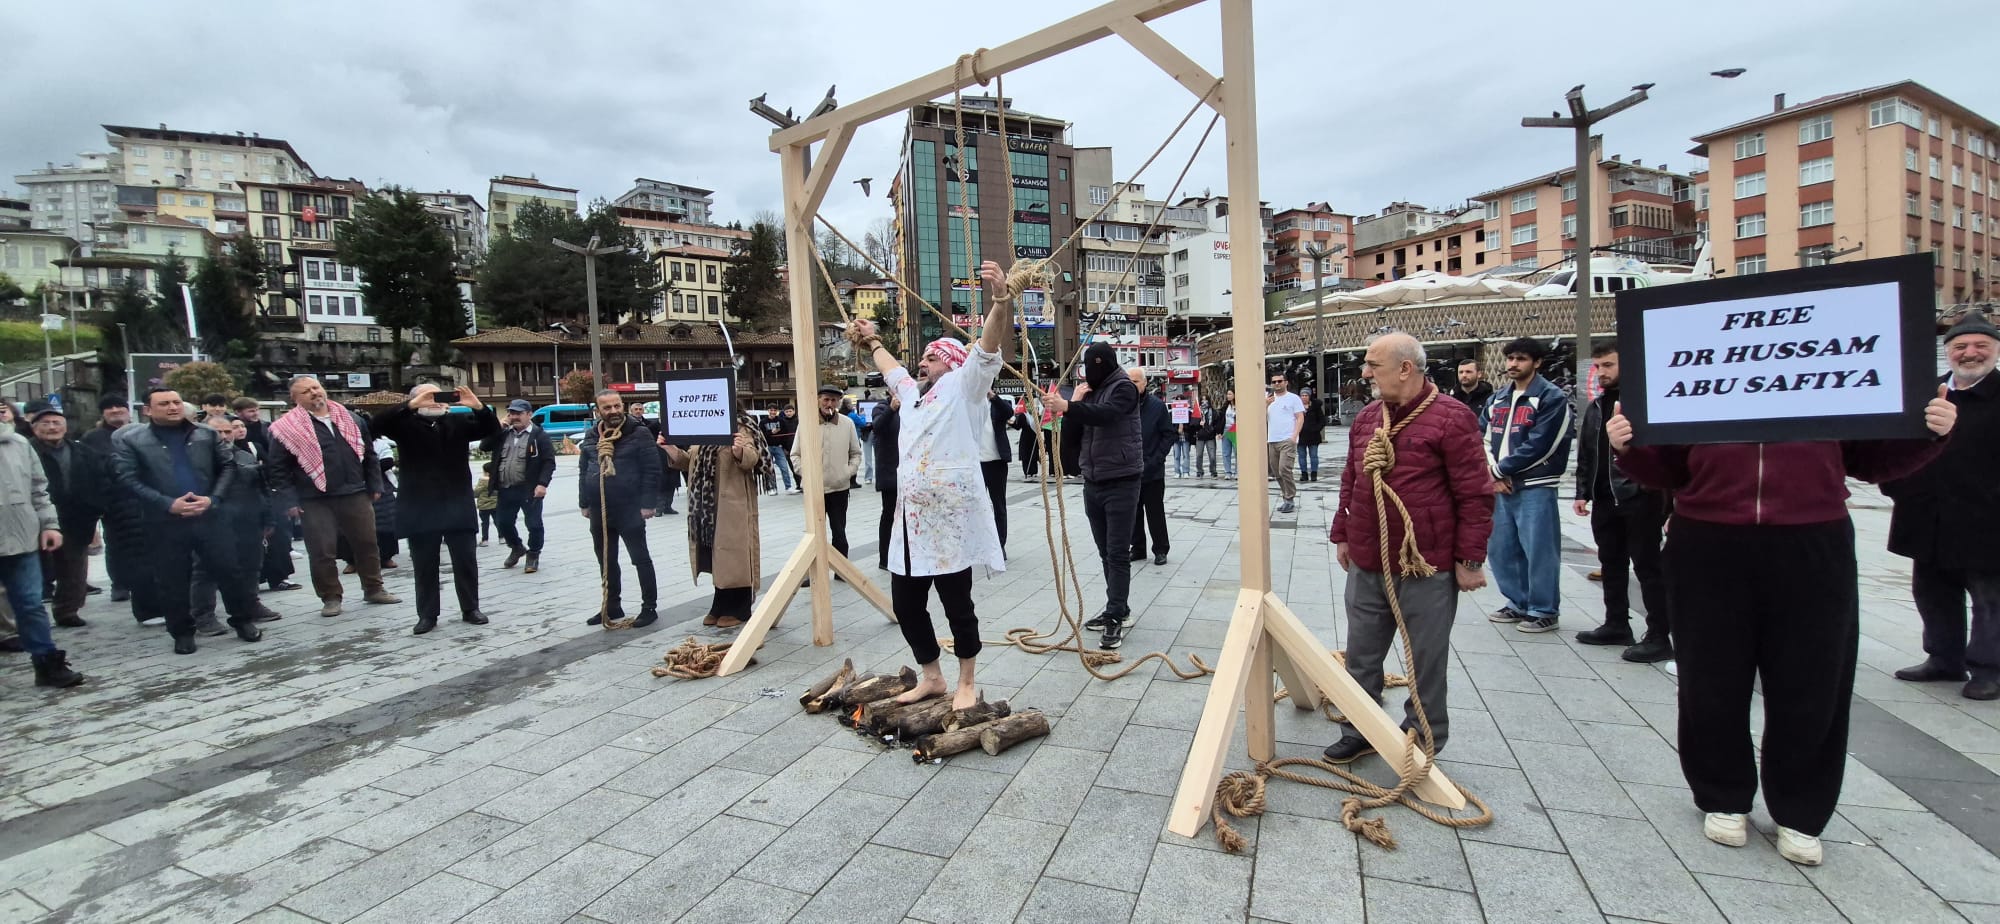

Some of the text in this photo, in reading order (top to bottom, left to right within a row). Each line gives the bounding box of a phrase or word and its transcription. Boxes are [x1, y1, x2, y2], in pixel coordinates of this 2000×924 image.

[1213, 240, 1230, 250] LOVE
[1720, 305, 1815, 331] FREE
[1667, 334, 1881, 368] DR HUSSAM
[1664, 368, 1881, 398] ABU SAFIYA
[678, 393, 719, 403] STOP THE
[672, 409, 725, 418] EXECUTIONS
